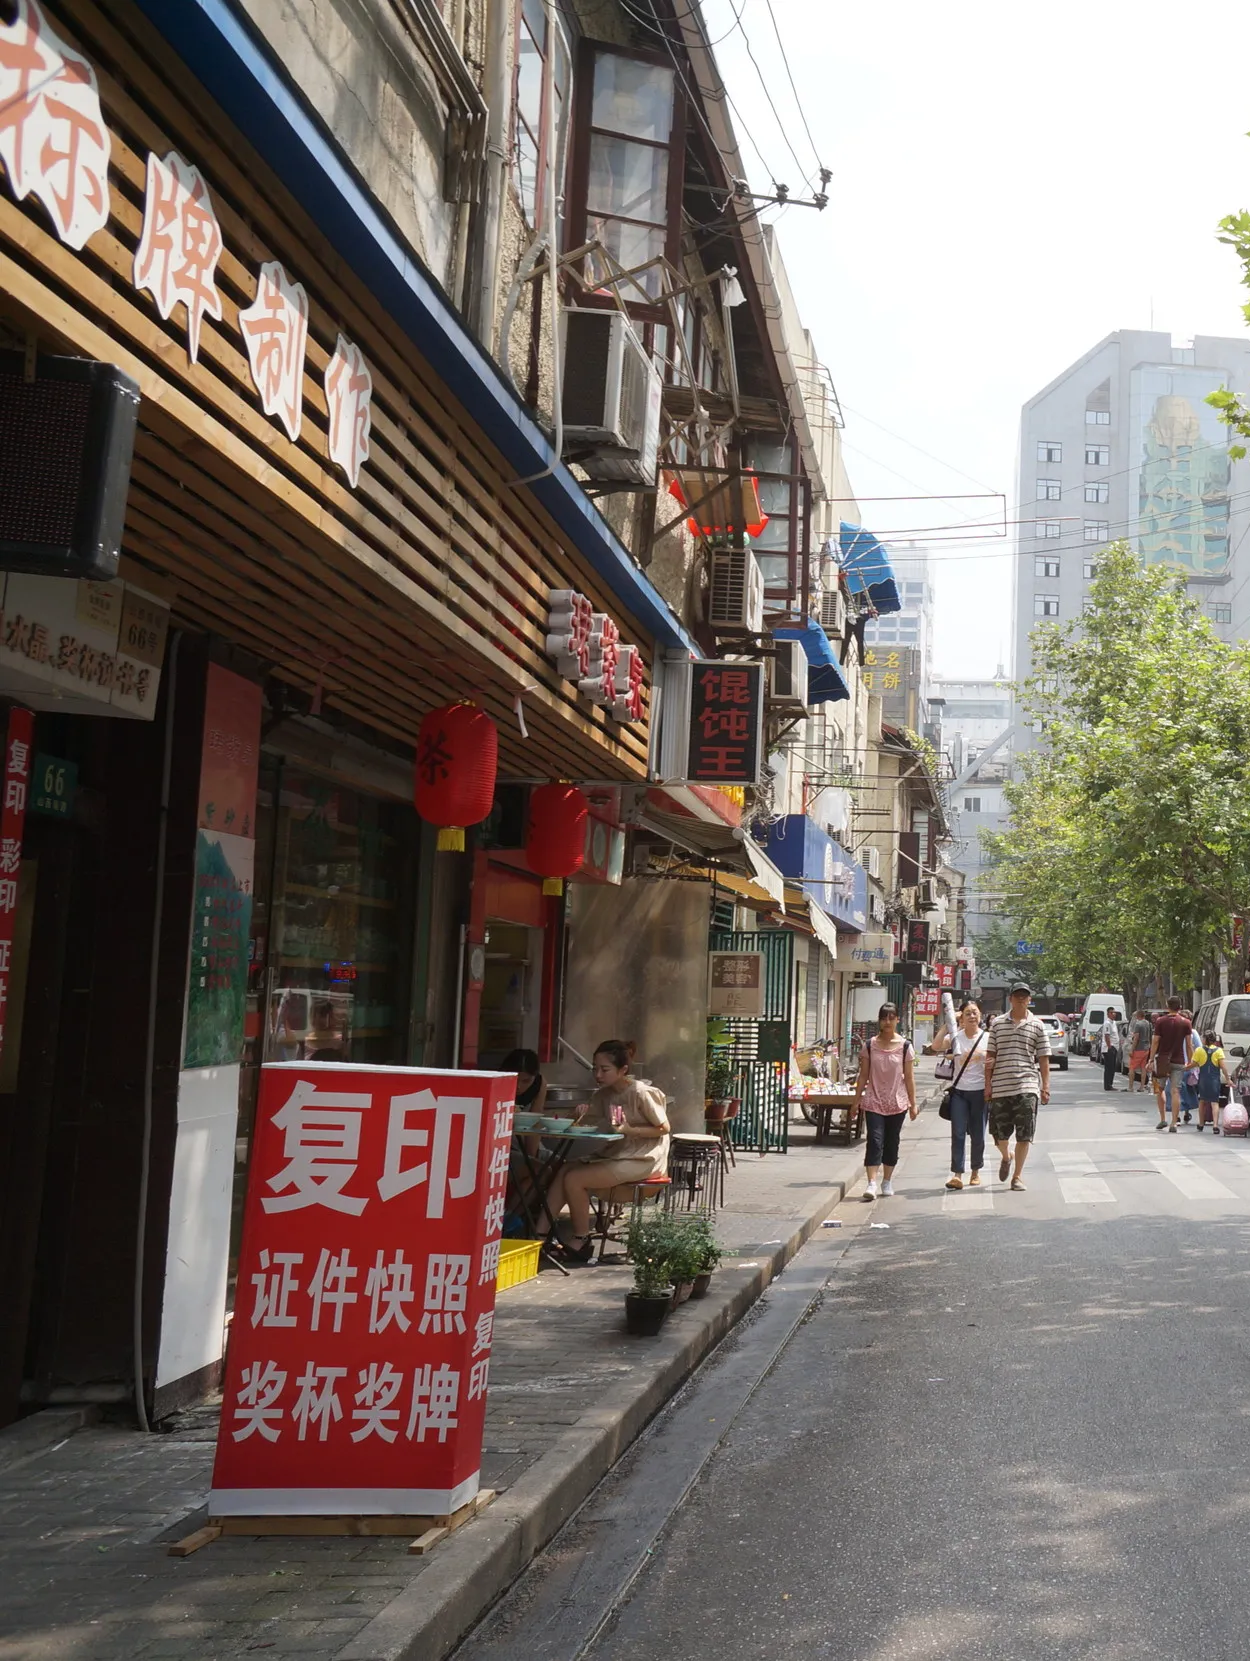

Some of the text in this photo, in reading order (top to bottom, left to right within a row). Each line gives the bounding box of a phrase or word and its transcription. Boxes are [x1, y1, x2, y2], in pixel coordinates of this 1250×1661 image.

[128, 623, 158, 655] 66号
[418, 729, 453, 786] 茶
[696, 669, 752, 777] 馄饨王
[6, 738, 30, 815] 复印
[44, 763, 66, 796] 66
[260, 1079, 484, 1220] 复印
[478, 1100, 514, 1286] 证件快照
[249, 1247, 471, 1336] 证件快照
[467, 1309, 495, 1402] 复印
[231, 1359, 461, 1444] 奖杯奖牌
